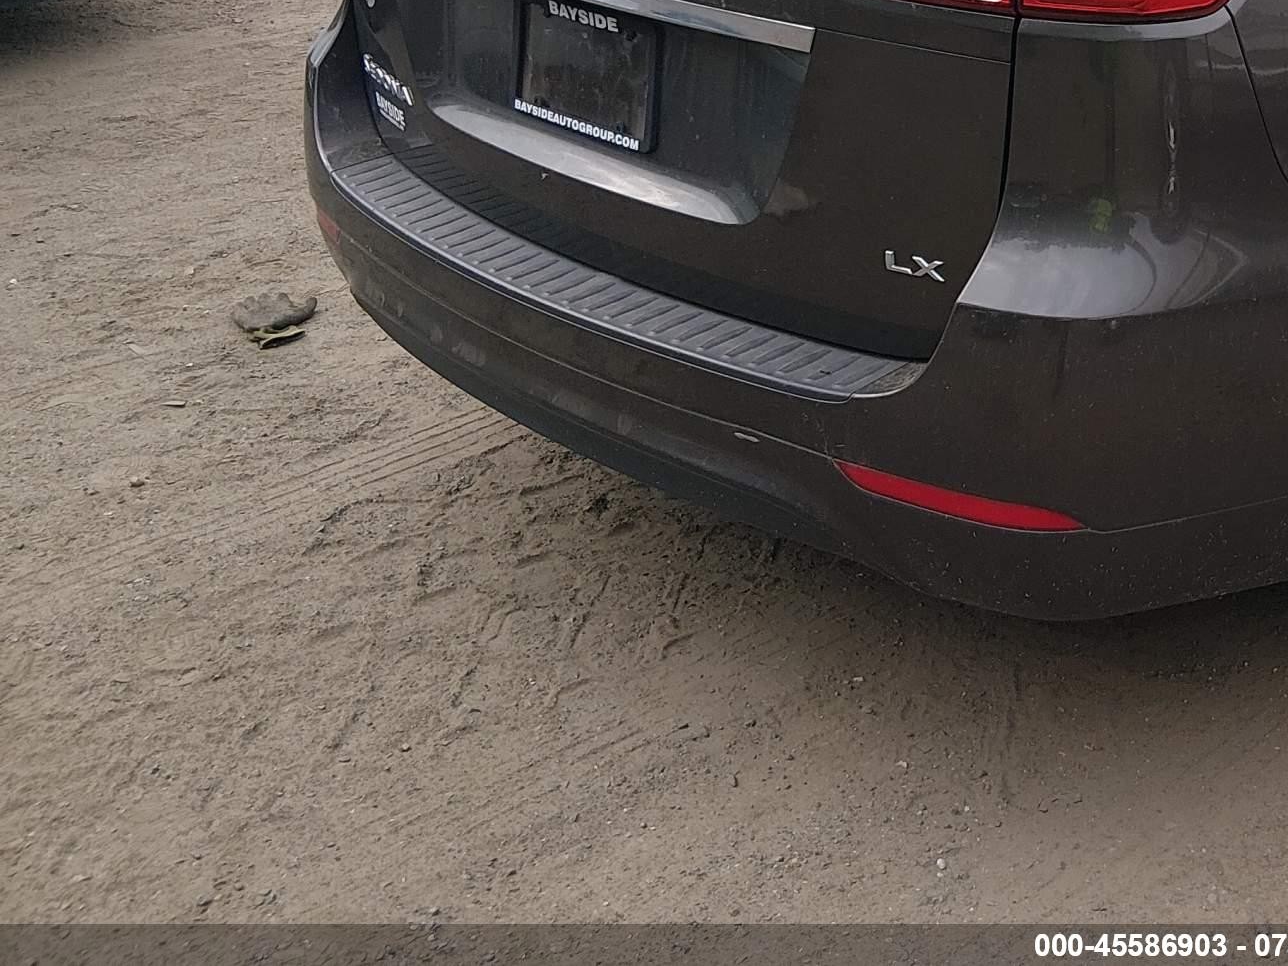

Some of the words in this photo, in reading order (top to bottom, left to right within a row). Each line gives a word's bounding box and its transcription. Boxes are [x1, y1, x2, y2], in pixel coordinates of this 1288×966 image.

[548, 0, 619, 33] BAYSIDE
[514, 98, 640, 152] BAYSIDEAUTOGROUP.COM
[884, 250, 945, 282] LX
